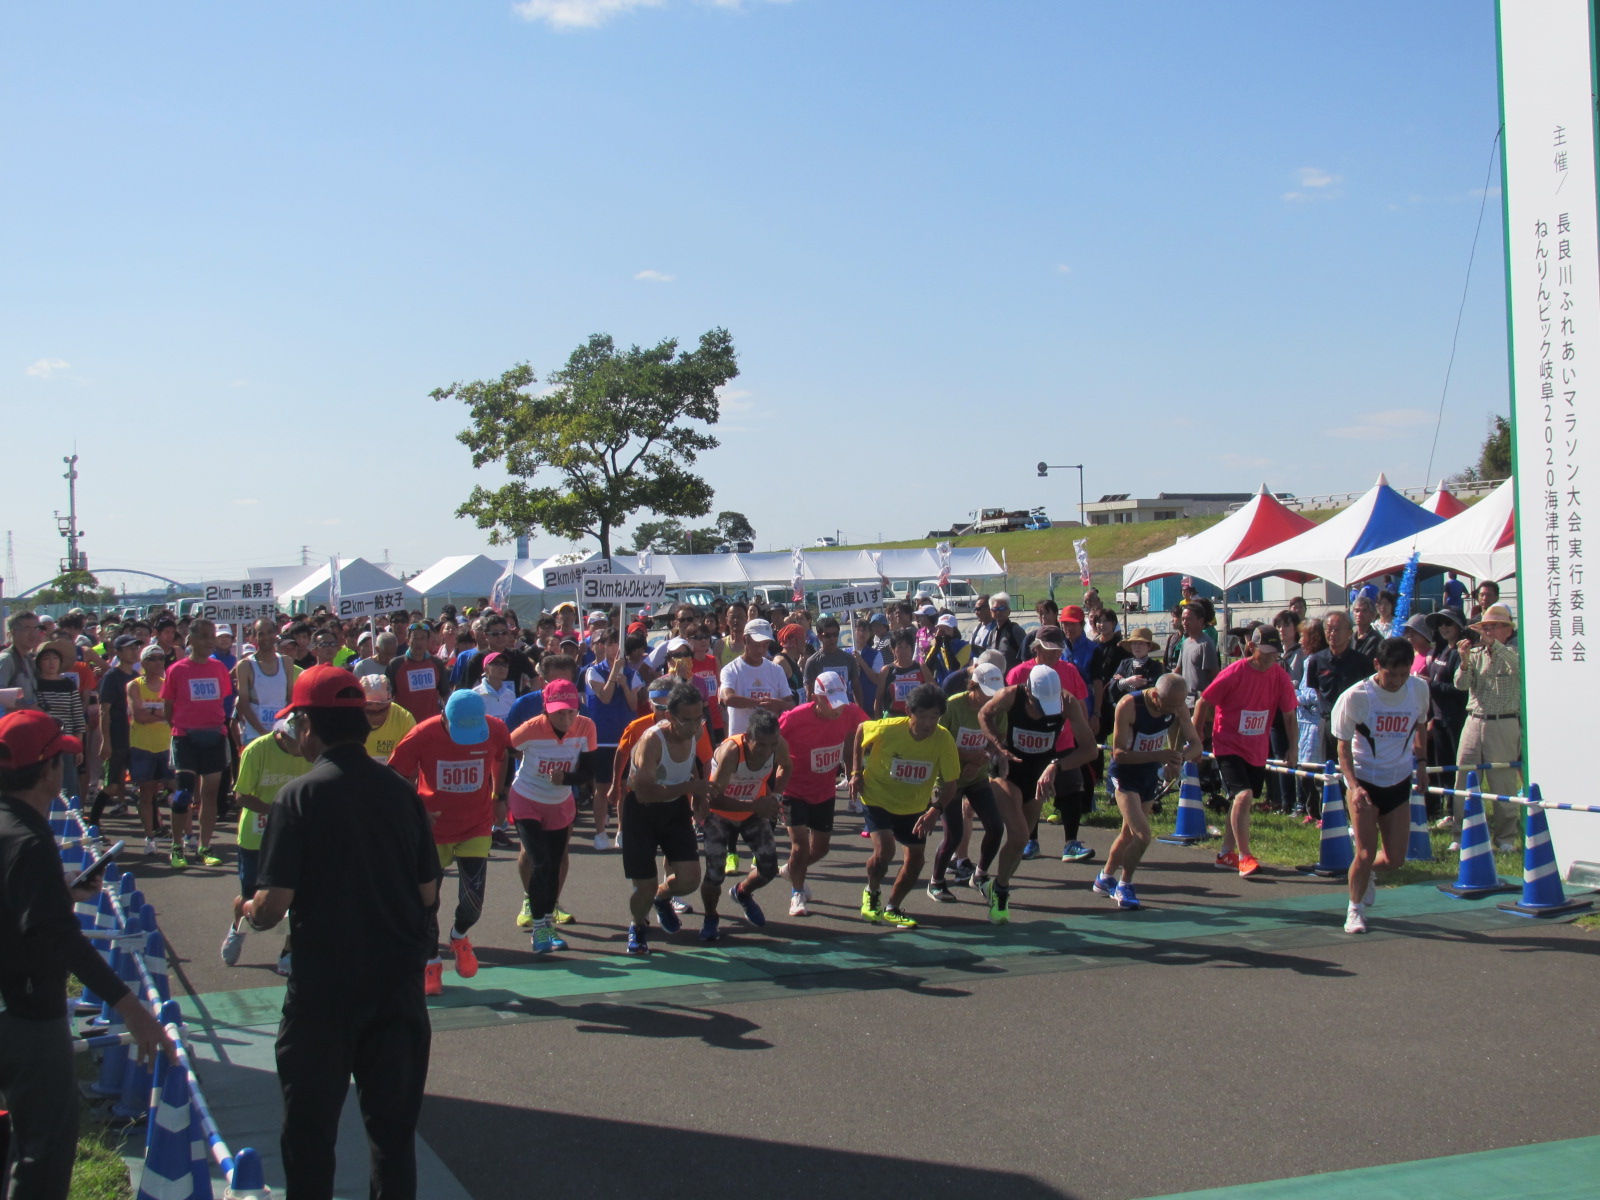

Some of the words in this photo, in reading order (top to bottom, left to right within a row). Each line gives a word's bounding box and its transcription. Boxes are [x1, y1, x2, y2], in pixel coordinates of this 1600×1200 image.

[206, 582, 273, 600] 2km一般男子
[820, 588, 880, 609] 2km車いす
[341, 592, 404, 615] 2km一般女子
[411, 672, 433, 686] 3010
[193, 683, 216, 695] 3013
[548, 692, 577, 701] adidas
[1244, 716, 1265, 729] 5017
[1376, 715, 1409, 732] 5002
[1017, 734, 1049, 748] 5001
[1139, 735, 1163, 750] 5013
[815, 750, 841, 768] 5019
[443, 766, 478, 785] 5016
[896, 764, 927, 779] 5010
[725, 783, 756, 796] 5012
